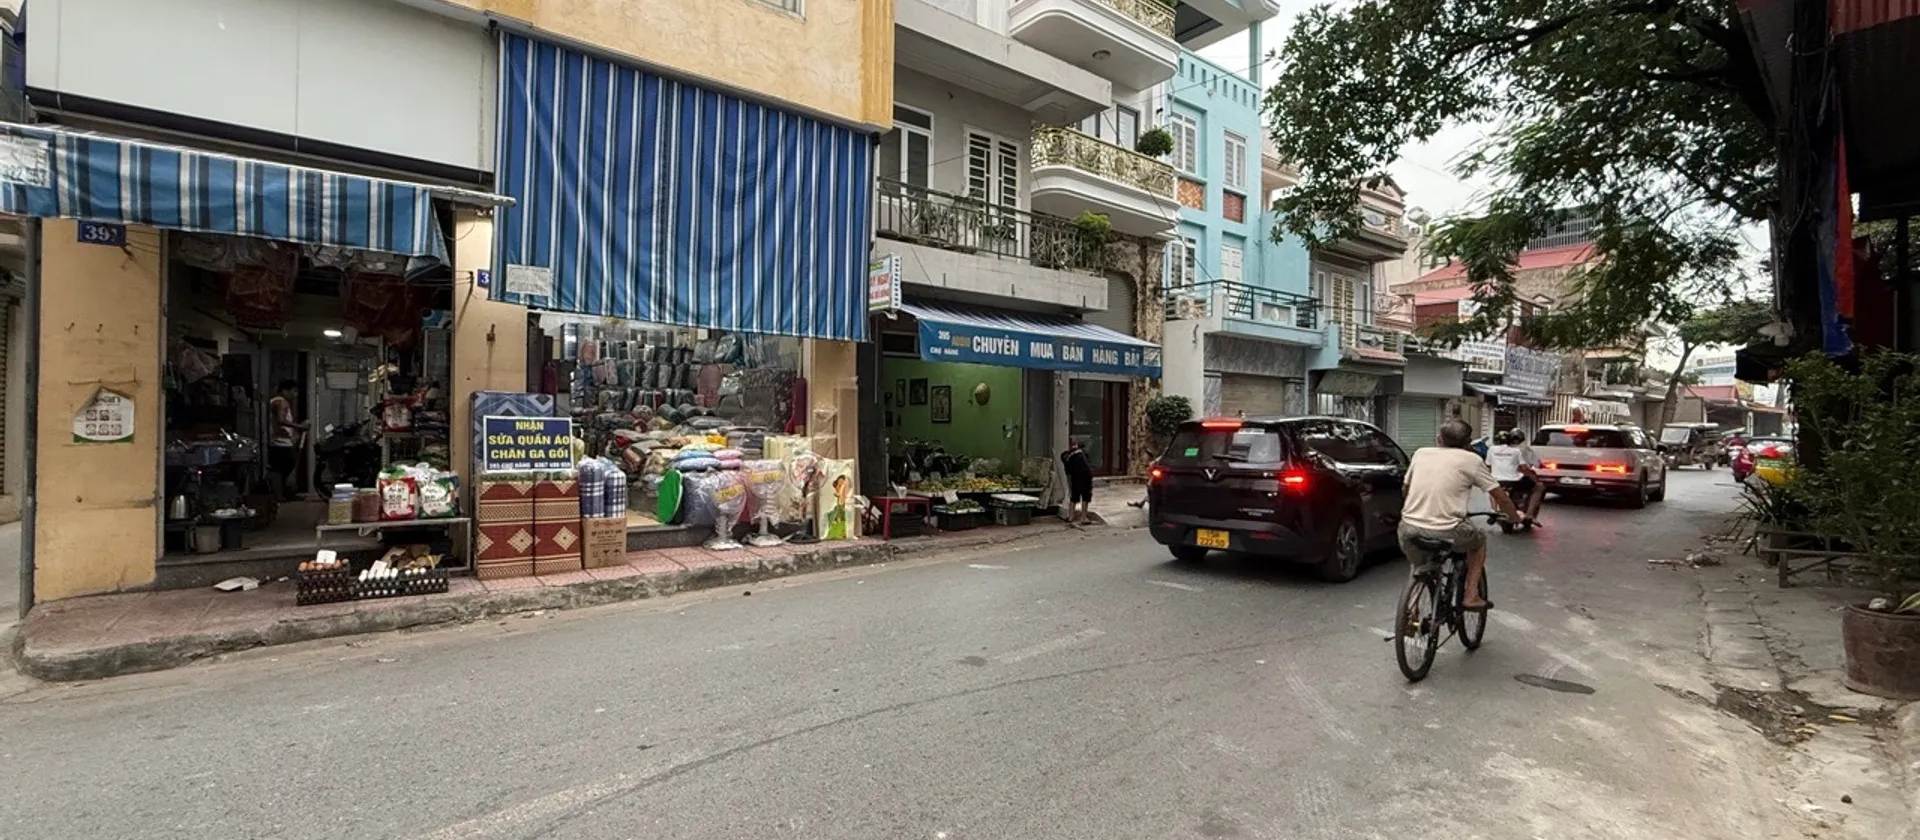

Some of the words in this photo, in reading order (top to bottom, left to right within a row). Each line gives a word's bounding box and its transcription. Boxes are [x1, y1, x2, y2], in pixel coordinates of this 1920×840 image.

[972, 334, 1019, 356] CHUYÊN
[1030, 341, 1054, 359] MUA
[1062, 342, 1084, 362] BÁN
[1092, 345, 1119, 365] HÀNG
[515, 421, 545, 433] NHẬN
[488, 432, 514, 445] SỬA
[554, 434, 570, 445] ÁO
[529, 449, 546, 459] GA
[548, 446, 569, 459] GỐI
